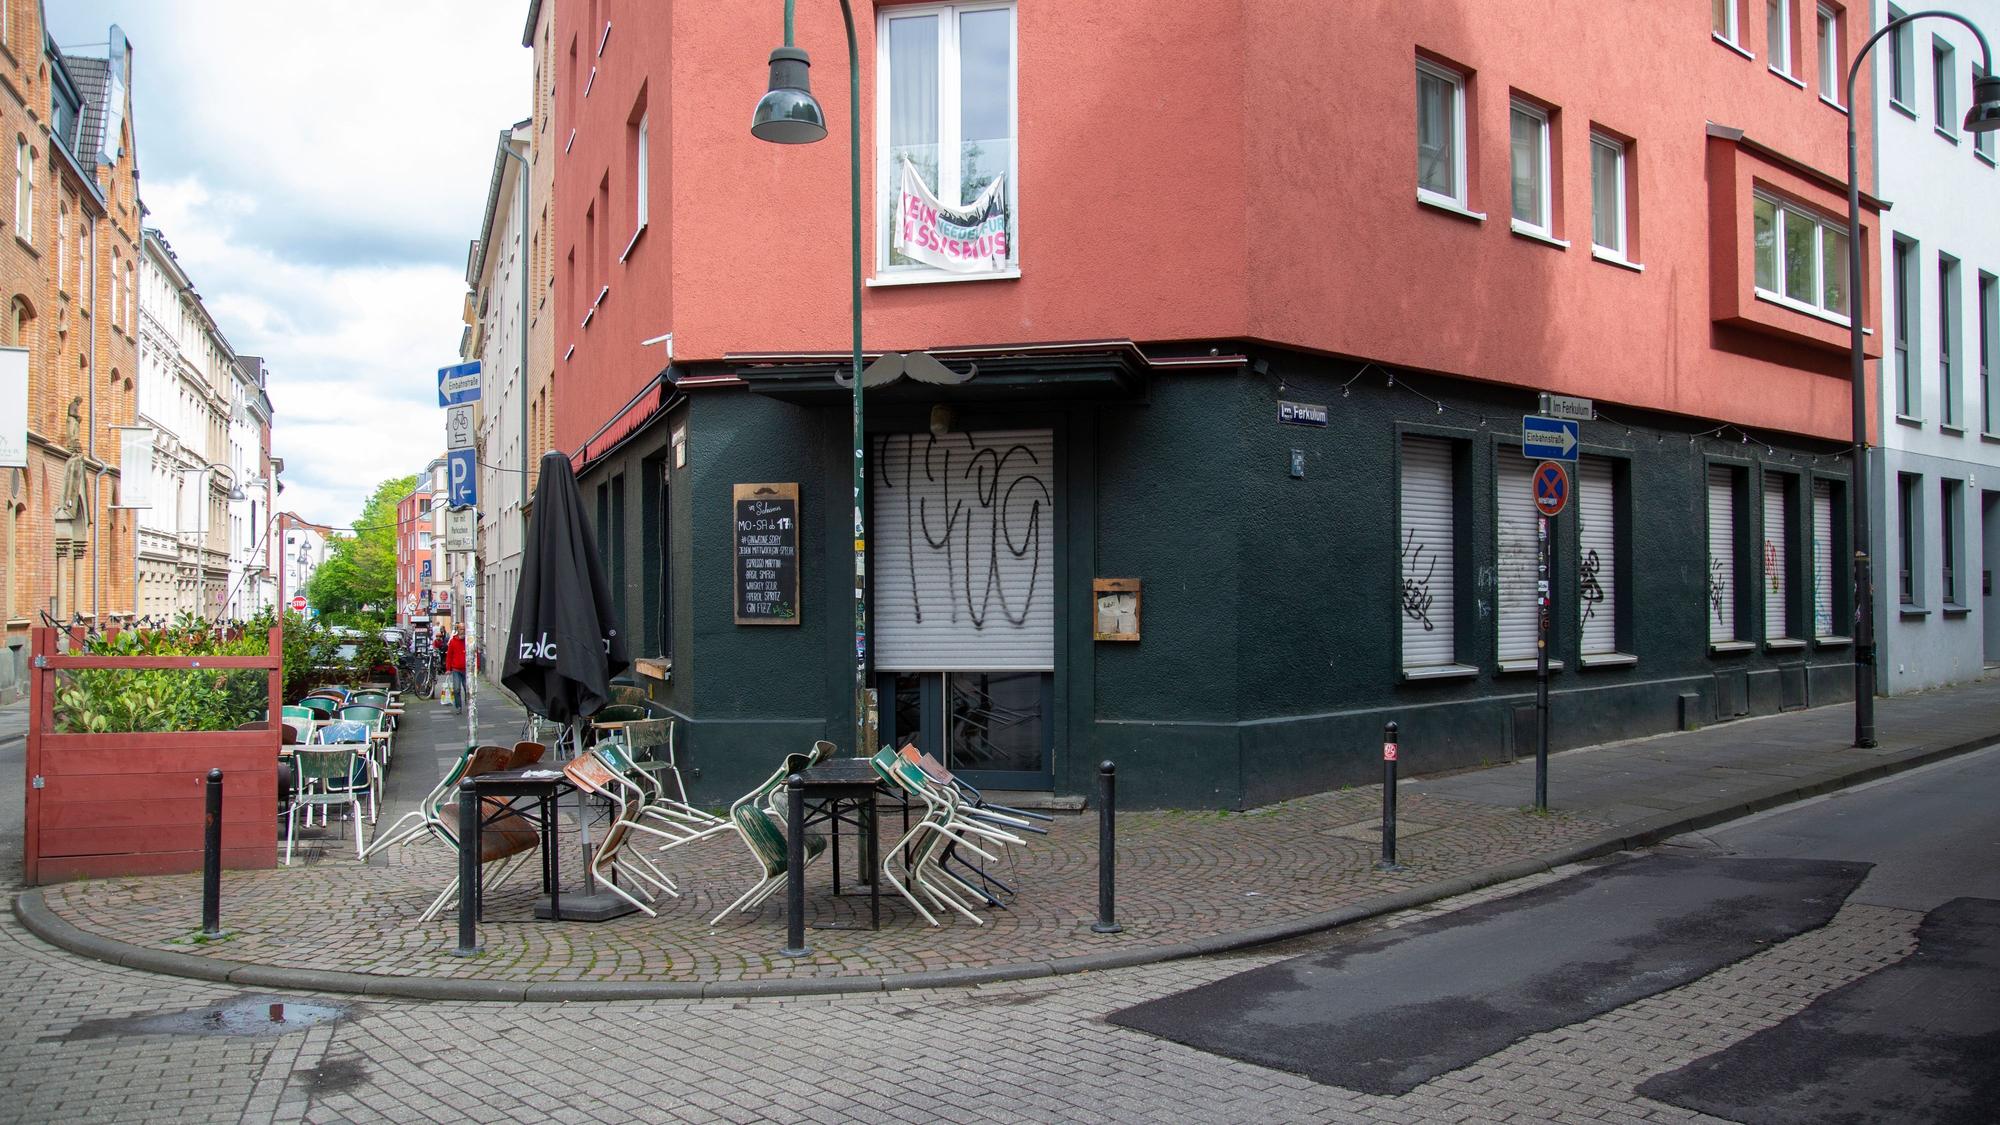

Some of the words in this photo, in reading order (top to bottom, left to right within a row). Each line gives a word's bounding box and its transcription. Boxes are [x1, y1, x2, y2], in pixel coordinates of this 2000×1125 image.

[903, 192, 937, 227] EIN
[1281, 403, 1292, 417] Im
[1293, 405, 1326, 422] Ferkulum
[1553, 400, 1561, 412] Im
[1562, 401, 1589, 416] Ferkulum
[1527, 432, 1564, 444] Einbahnstraße
[452, 457, 467, 500] P
